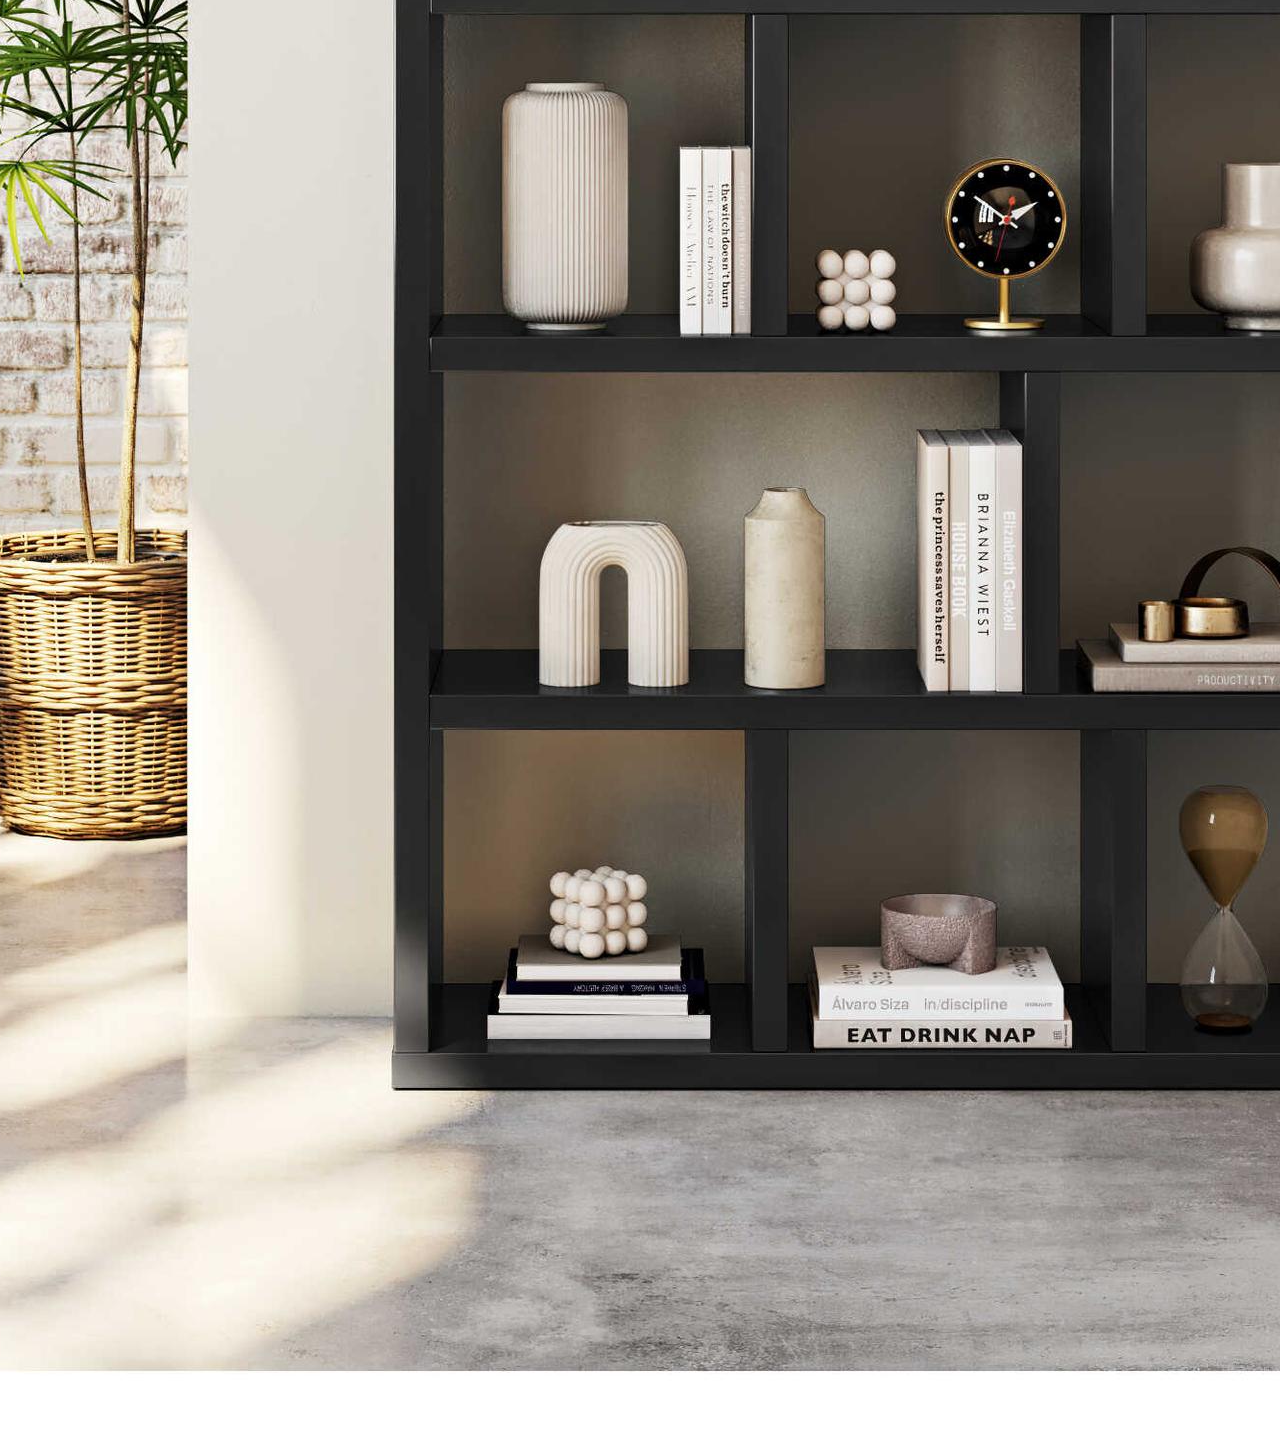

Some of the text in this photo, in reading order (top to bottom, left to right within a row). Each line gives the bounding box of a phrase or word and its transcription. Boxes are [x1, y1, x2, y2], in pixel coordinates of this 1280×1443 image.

[721, 183, 730, 308] the witch doesn't burn
[933, 492, 945, 663] the princess saves herself
[952, 522, 967, 620] HOUSE BOOK
[977, 493, 989, 636] BRIANNA WIEST
[1003, 511, 1016, 631] Elizabeth Gaskell
[1197, 675, 1275, 685] PRODUCTIVITY
[832, 995, 877, 1011] Álvaro
[880, 998, 909, 1011] Siza
[924, 998, 1008, 1013] in/discipline
[847, 1027, 892, 1043] EAT
[900, 1027, 977, 1043] DRINK
[985, 1027, 1036, 1043] NAP
